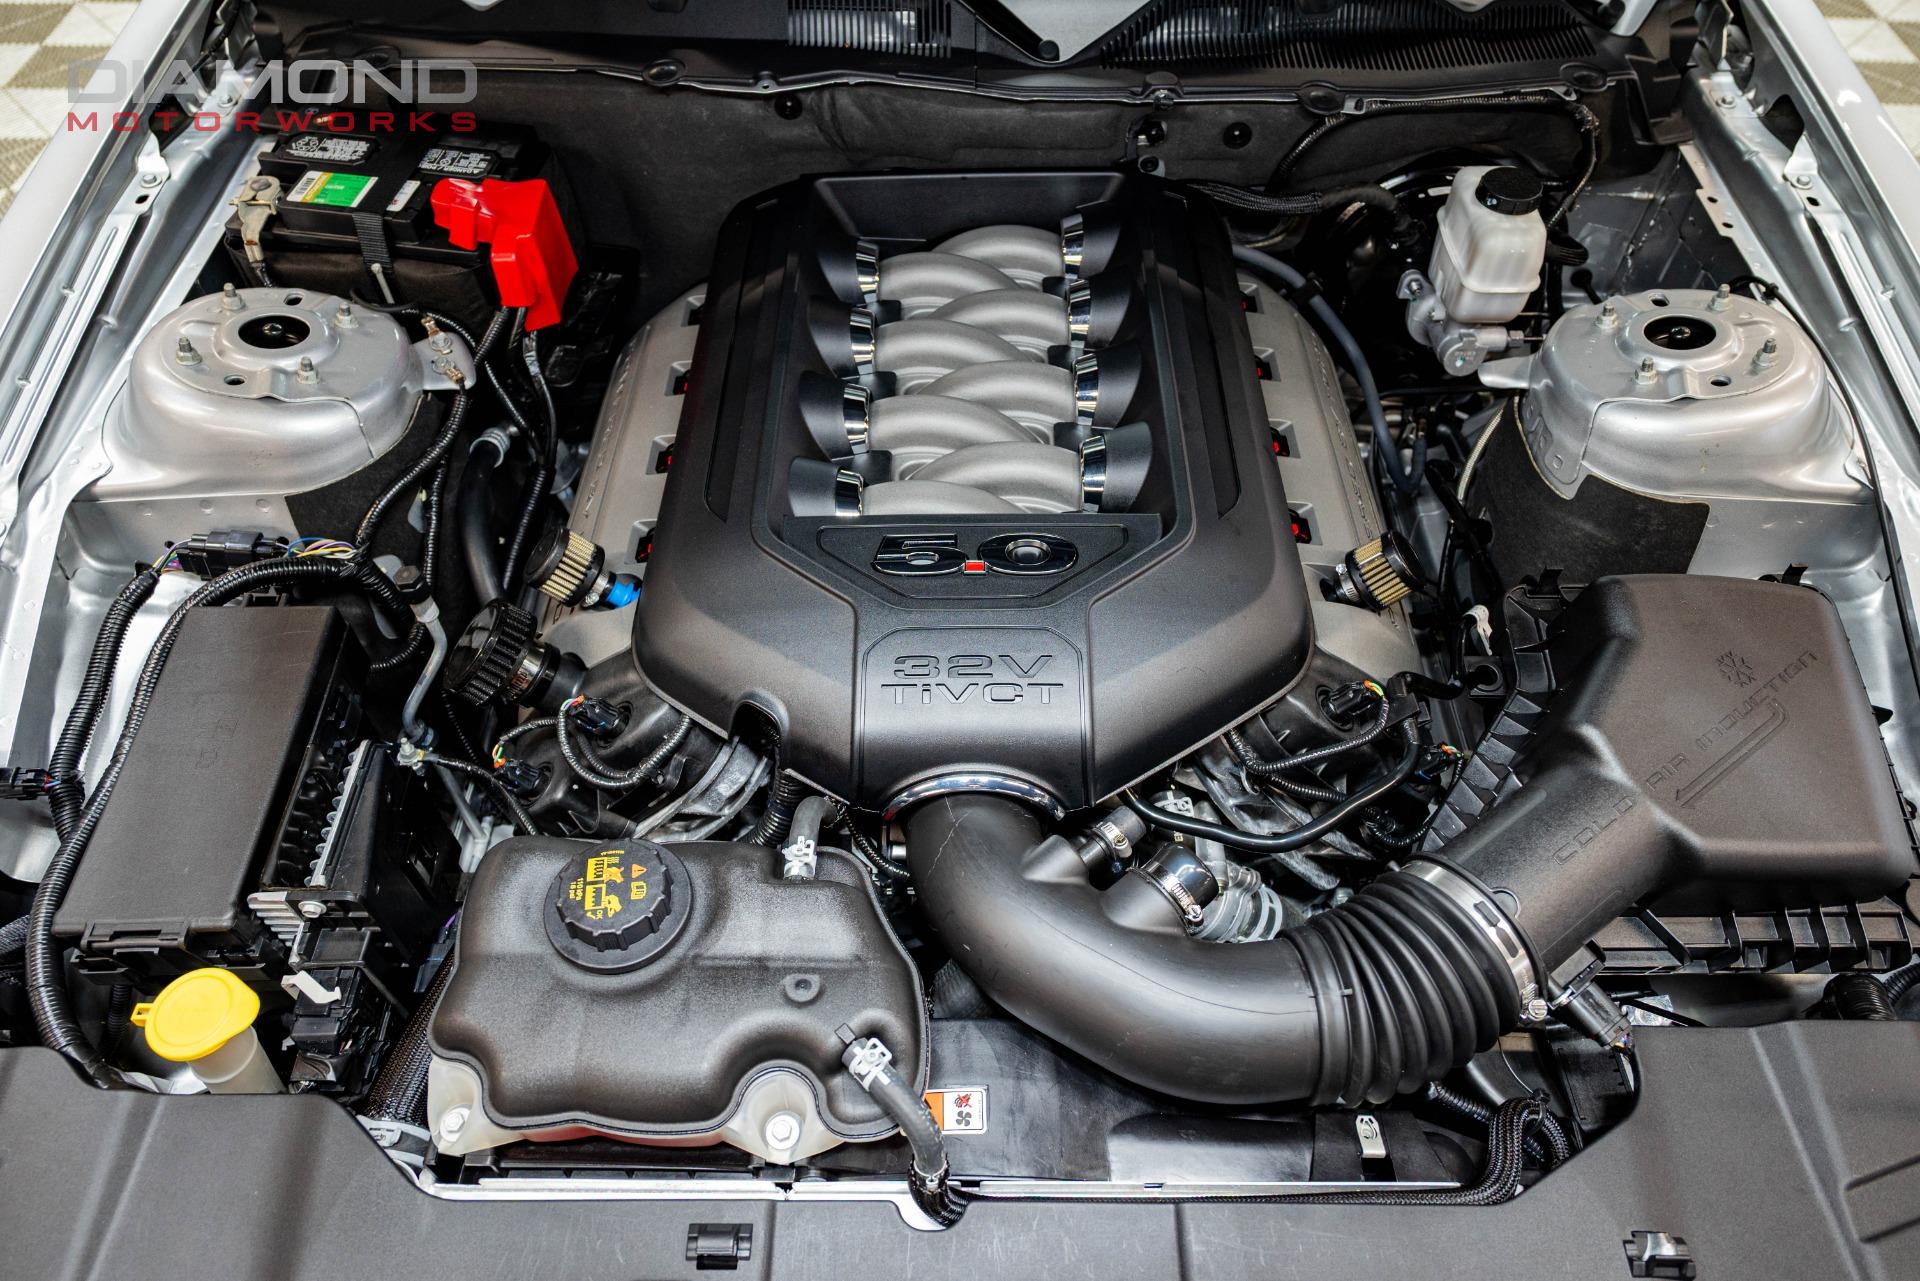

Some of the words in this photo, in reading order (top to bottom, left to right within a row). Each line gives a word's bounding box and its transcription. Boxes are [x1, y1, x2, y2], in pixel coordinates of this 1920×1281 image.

[871, 533, 1079, 576] 5.0
[893, 654, 1053, 680] 32V
[880, 682, 1065, 705] TiVCT
[1552, 795, 1635, 866] COLD
[1646, 752, 1690, 791] AIR
[1695, 650, 1818, 751] INDUCTION
